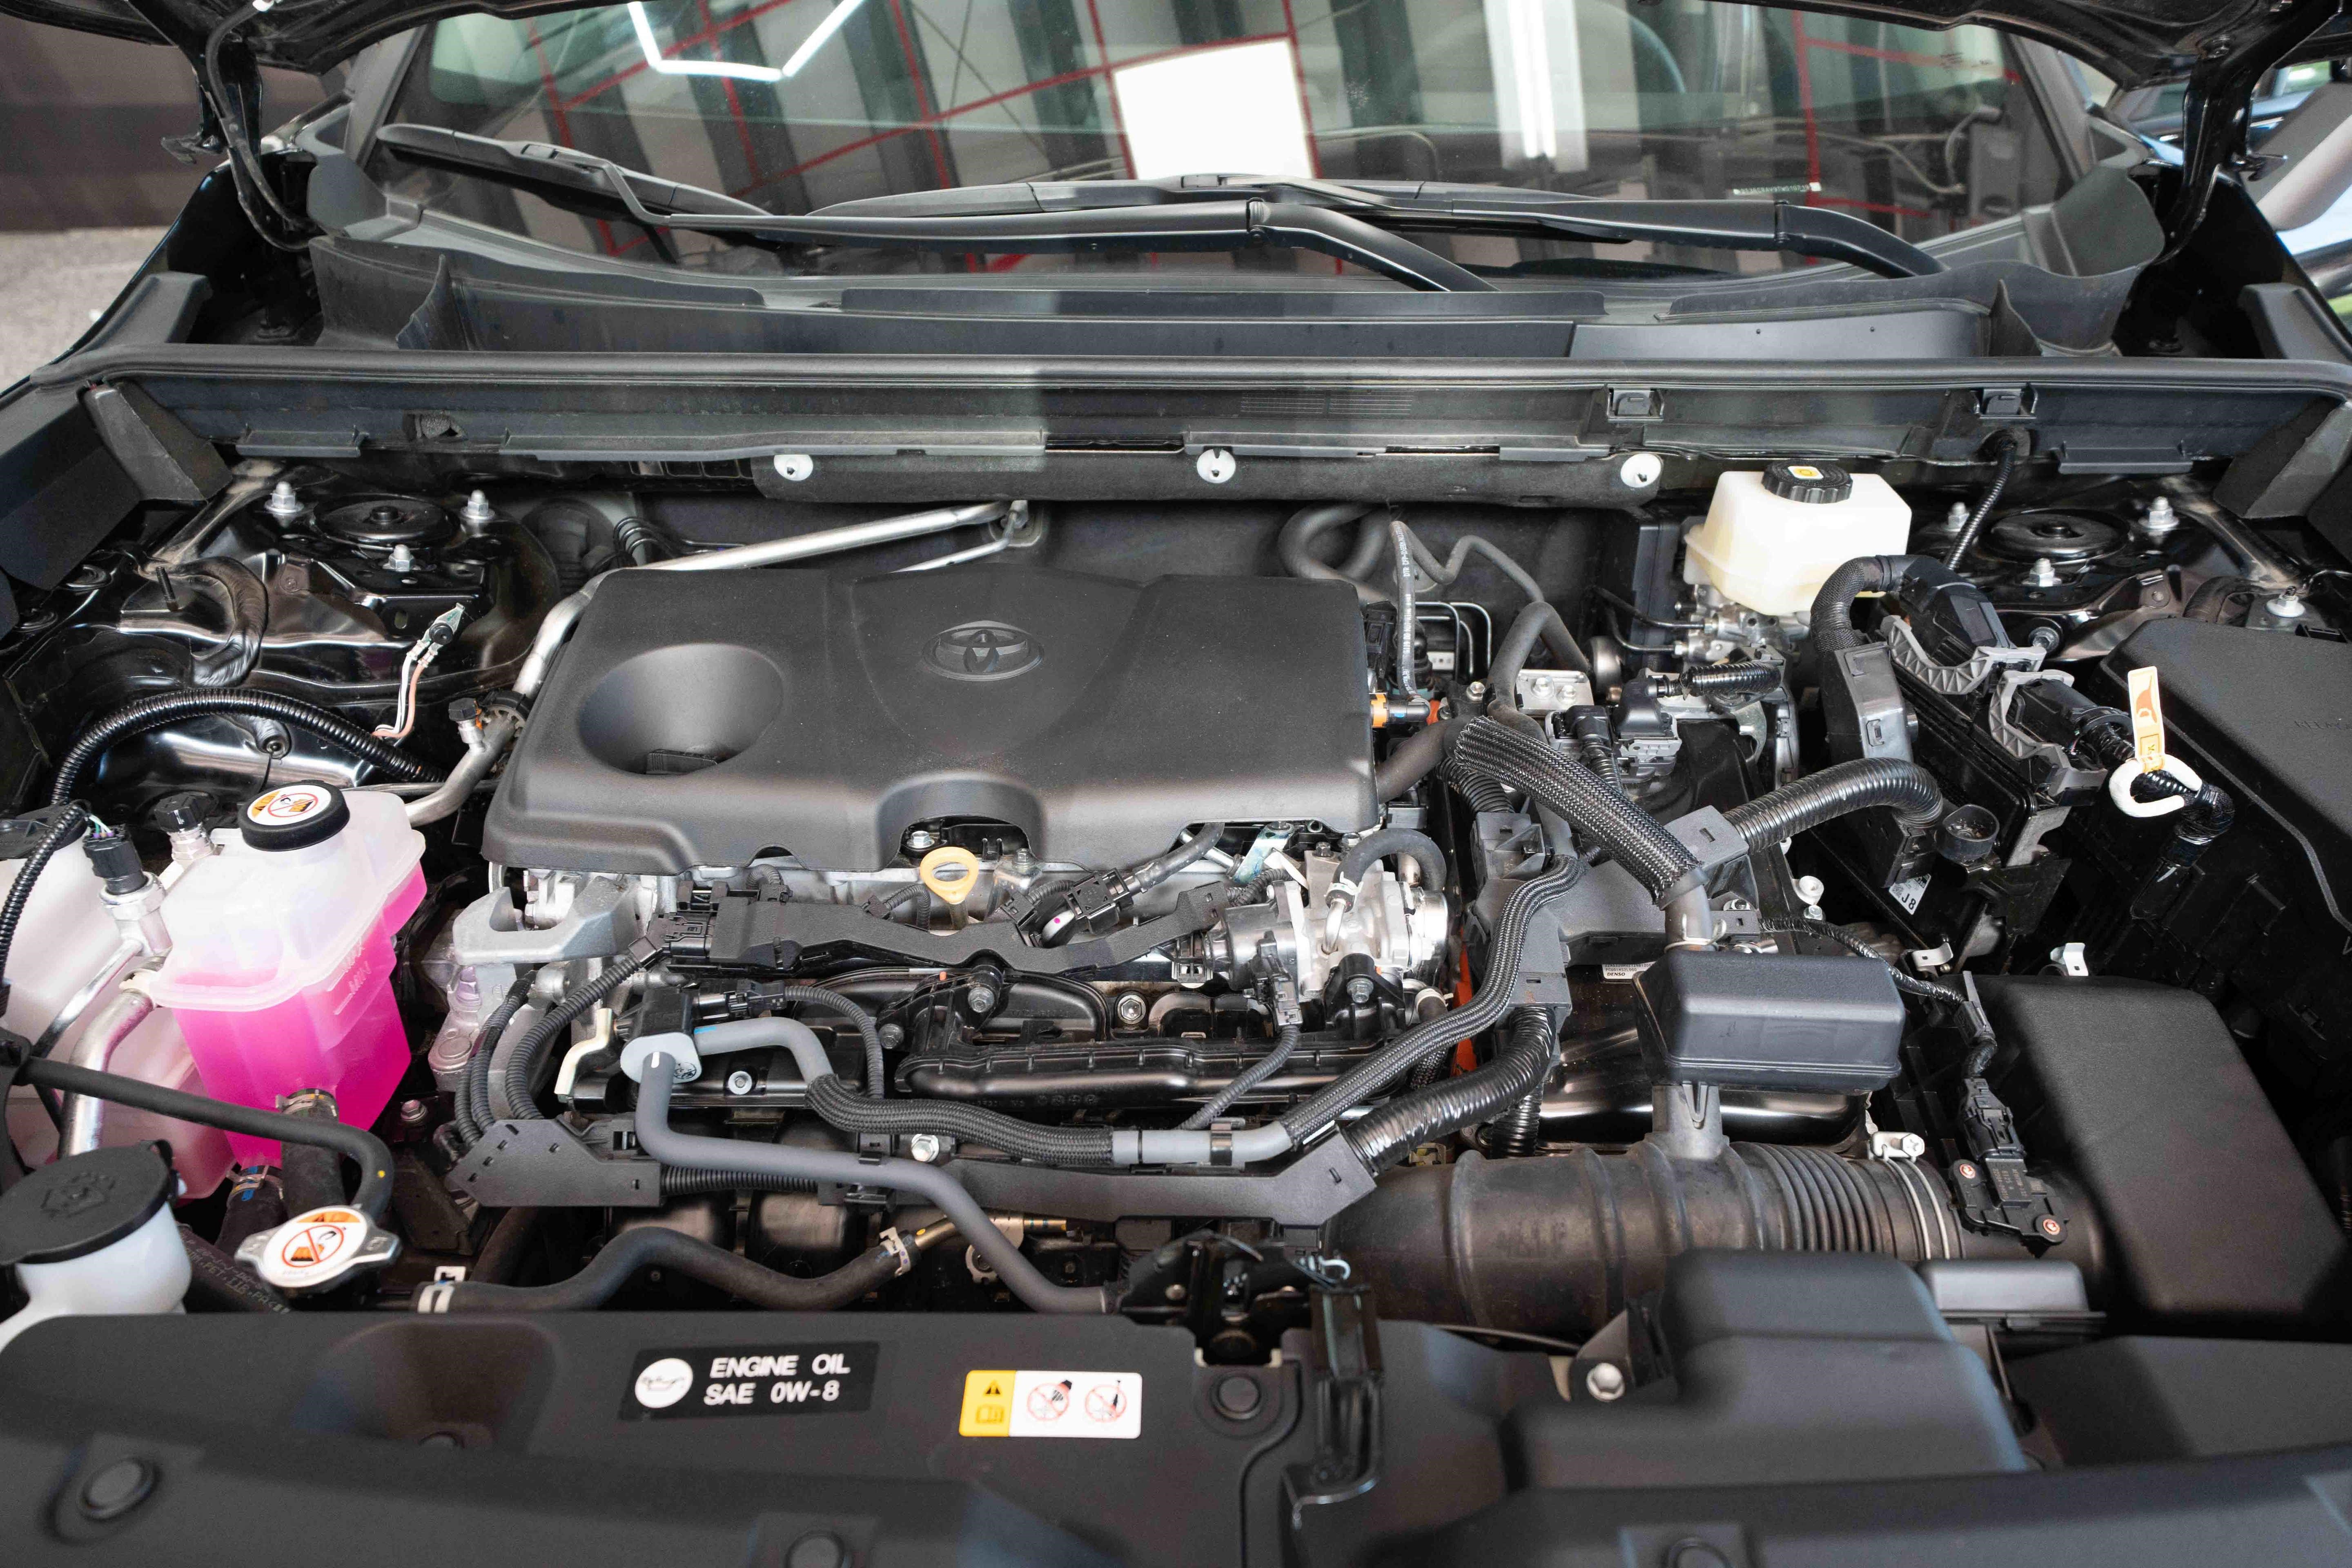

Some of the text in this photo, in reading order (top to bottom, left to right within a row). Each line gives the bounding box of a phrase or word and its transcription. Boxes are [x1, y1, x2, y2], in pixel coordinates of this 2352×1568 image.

[710, 1353, 850, 1379] ENGINE OIL
[704, 1380, 840, 1405] SAE 0W-8
